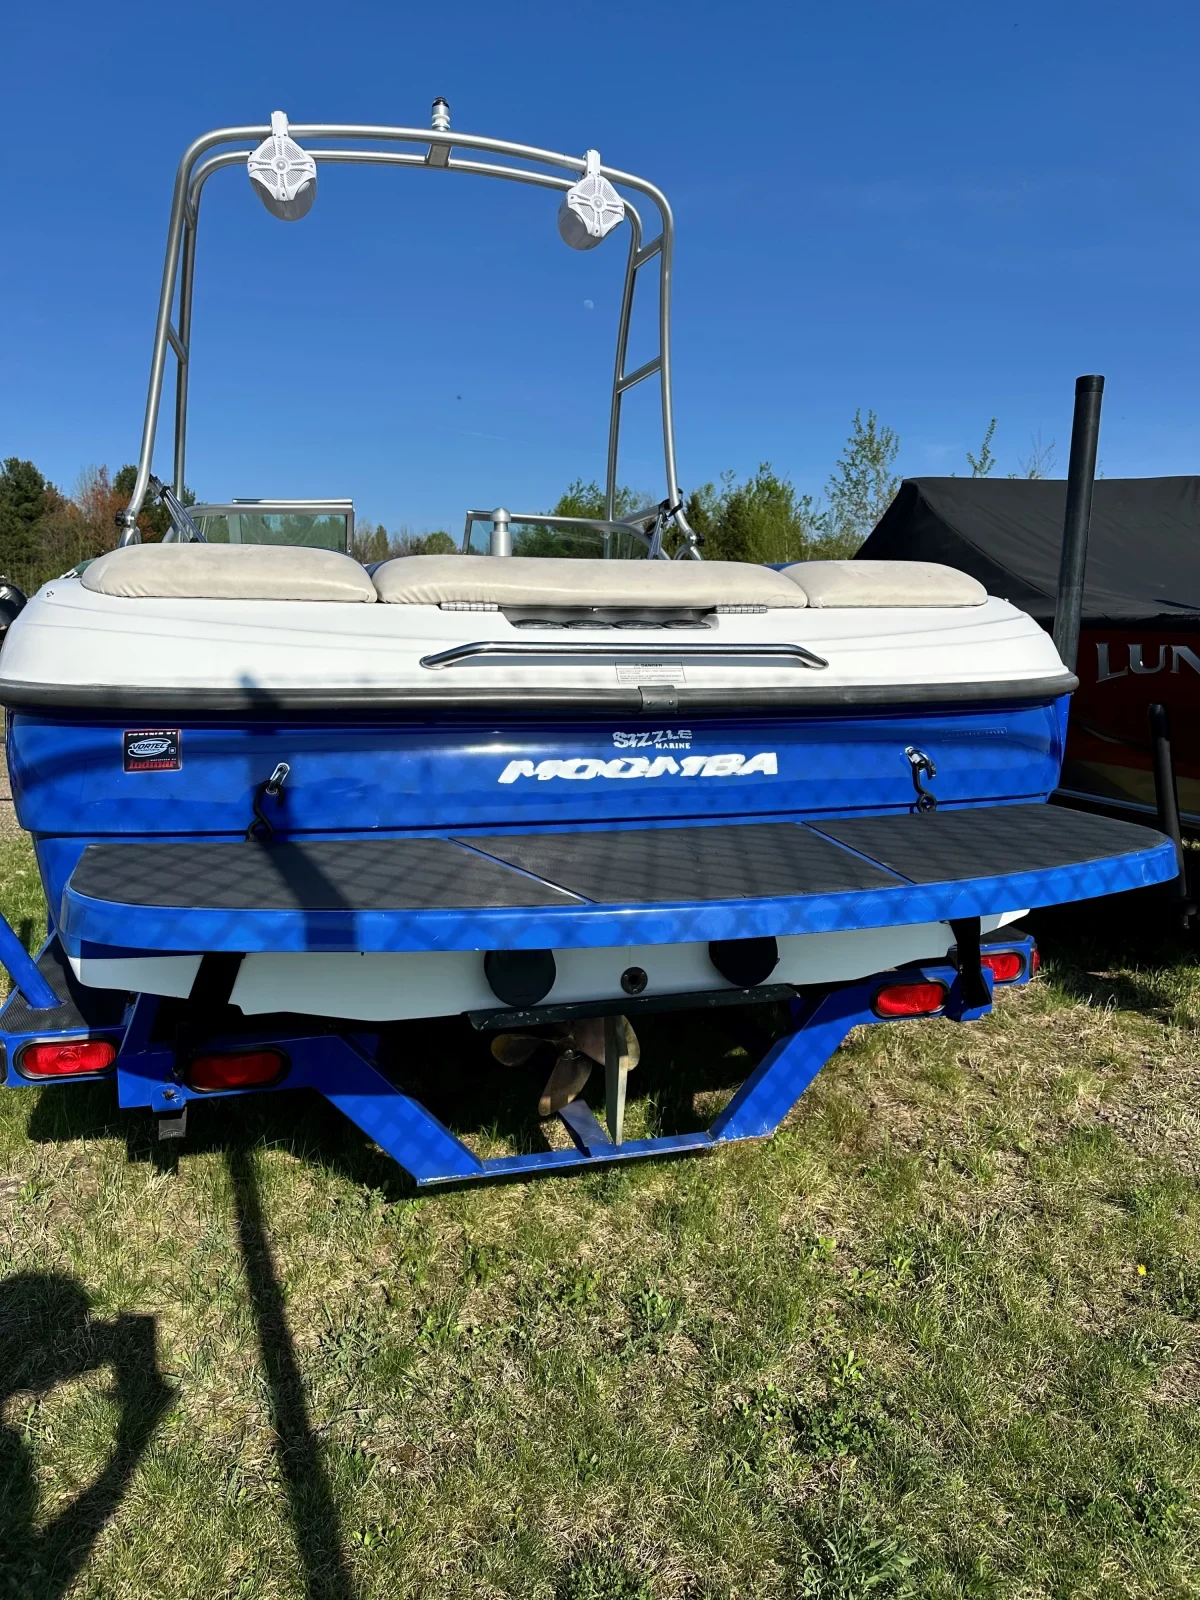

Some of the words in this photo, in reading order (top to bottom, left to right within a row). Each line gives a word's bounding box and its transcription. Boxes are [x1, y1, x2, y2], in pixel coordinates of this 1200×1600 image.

[1095, 642, 1200, 683] LUN
[132, 742, 167, 750] VORTEC
[612, 730, 692, 748] SIZZLE
[498, 752, 778, 784] MOOMBA
